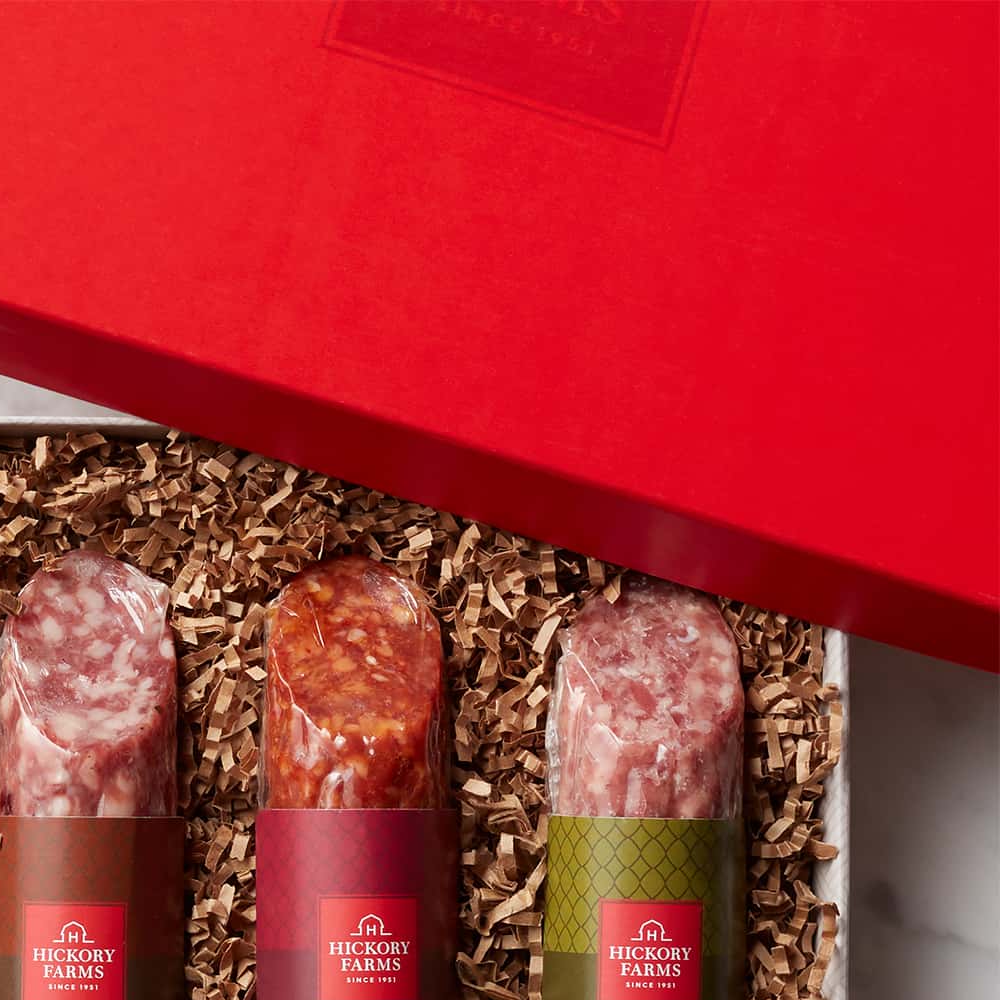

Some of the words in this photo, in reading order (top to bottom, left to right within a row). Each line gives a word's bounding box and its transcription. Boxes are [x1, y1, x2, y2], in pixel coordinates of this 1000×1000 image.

[33, 948, 116, 963] HICKORY
[328, 941, 410, 956] HICKORY
[608, 945, 692, 961] HICKORY
[43, 965, 104, 979] FARMS
[340, 958, 401, 972] FARMS
[620, 963, 681, 977] FARMS
[48, 983, 76, 991] SINCE
[79, 983, 99, 991] 1951
[625, 981, 654, 989] SINCE
[657, 981, 676, 989] 1951
